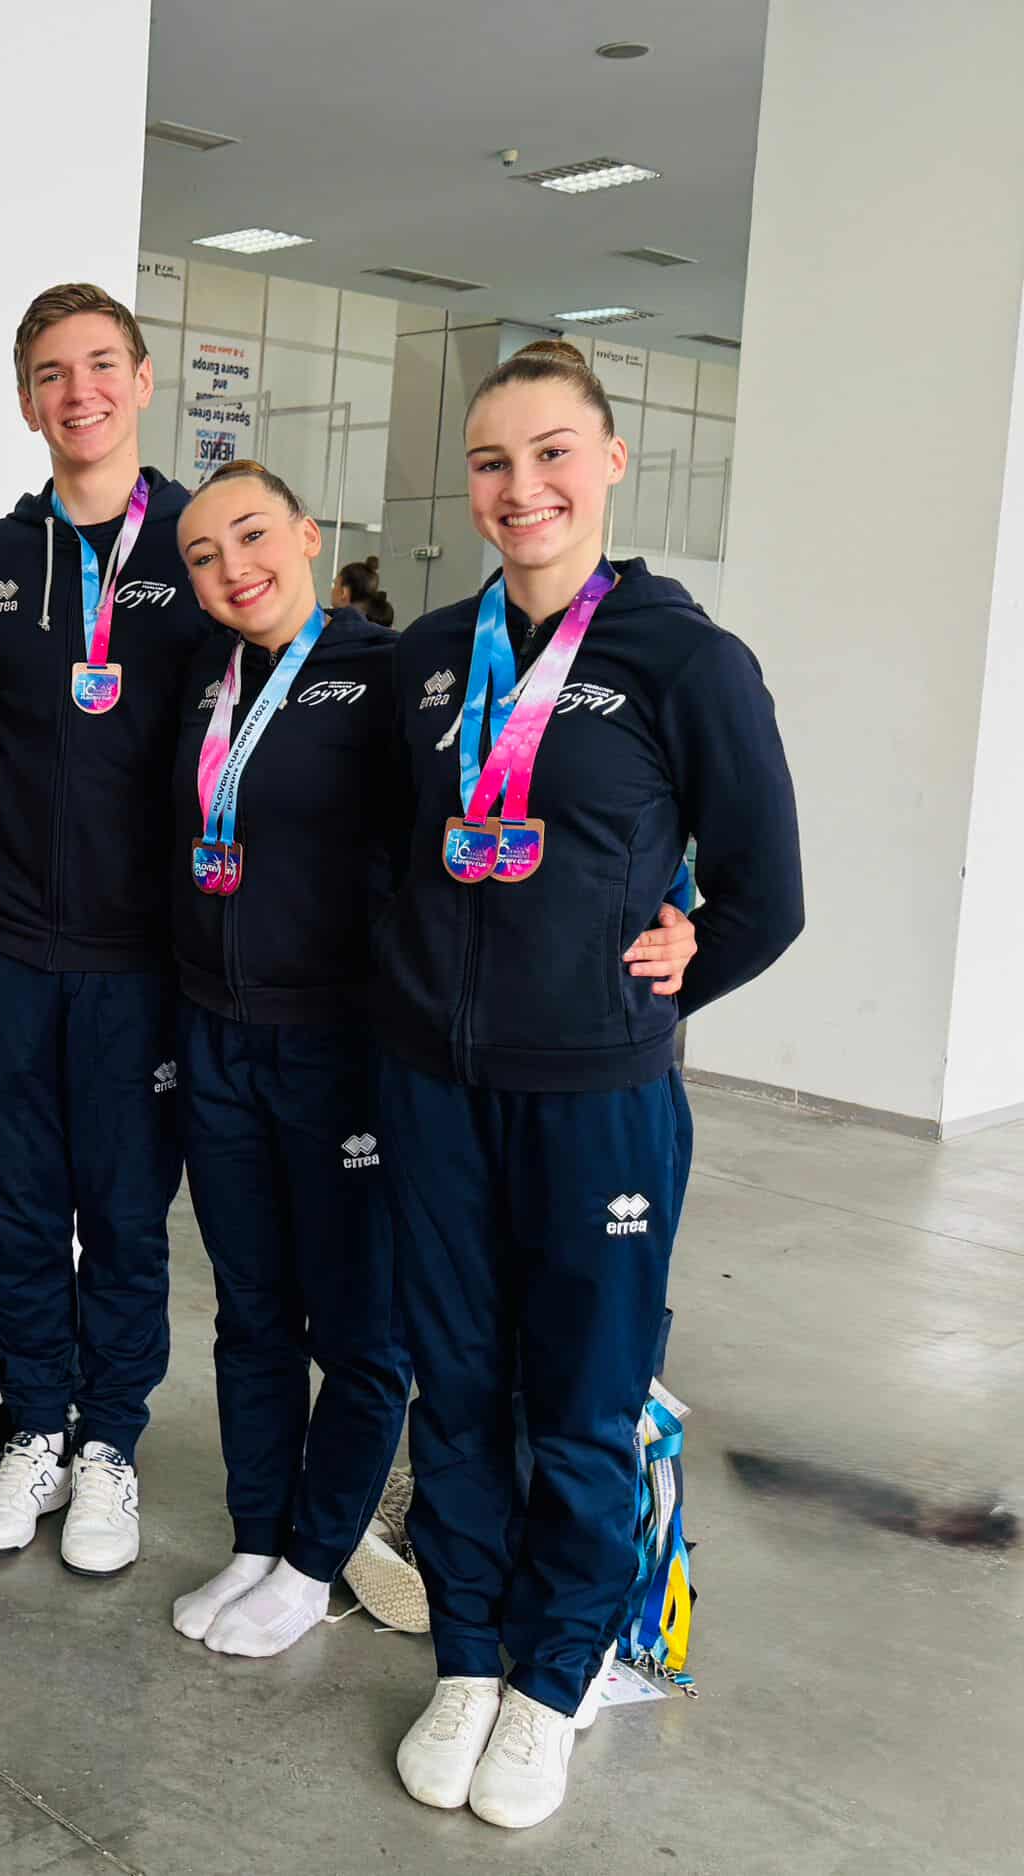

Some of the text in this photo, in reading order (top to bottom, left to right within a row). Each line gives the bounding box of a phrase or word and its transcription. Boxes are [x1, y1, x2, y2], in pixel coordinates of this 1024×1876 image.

[192, 357, 250, 378] Secure Europe
[213, 410, 225, 424] for
[226, 410, 251, 427] Space
[114, 580, 176, 609] Gym
[296, 680, 367, 706] Gym
[419, 693, 451, 710] errea
[197, 698, 217, 709] erre
[213, 769, 231, 812] PLOVDIV
[227, 749, 240, 768] CUP
[238, 722, 255, 749] OPEN
[252, 699, 270, 723] 2025
[342, 1151, 380, 1169] errea
[606, 1220, 648, 1235] errea
